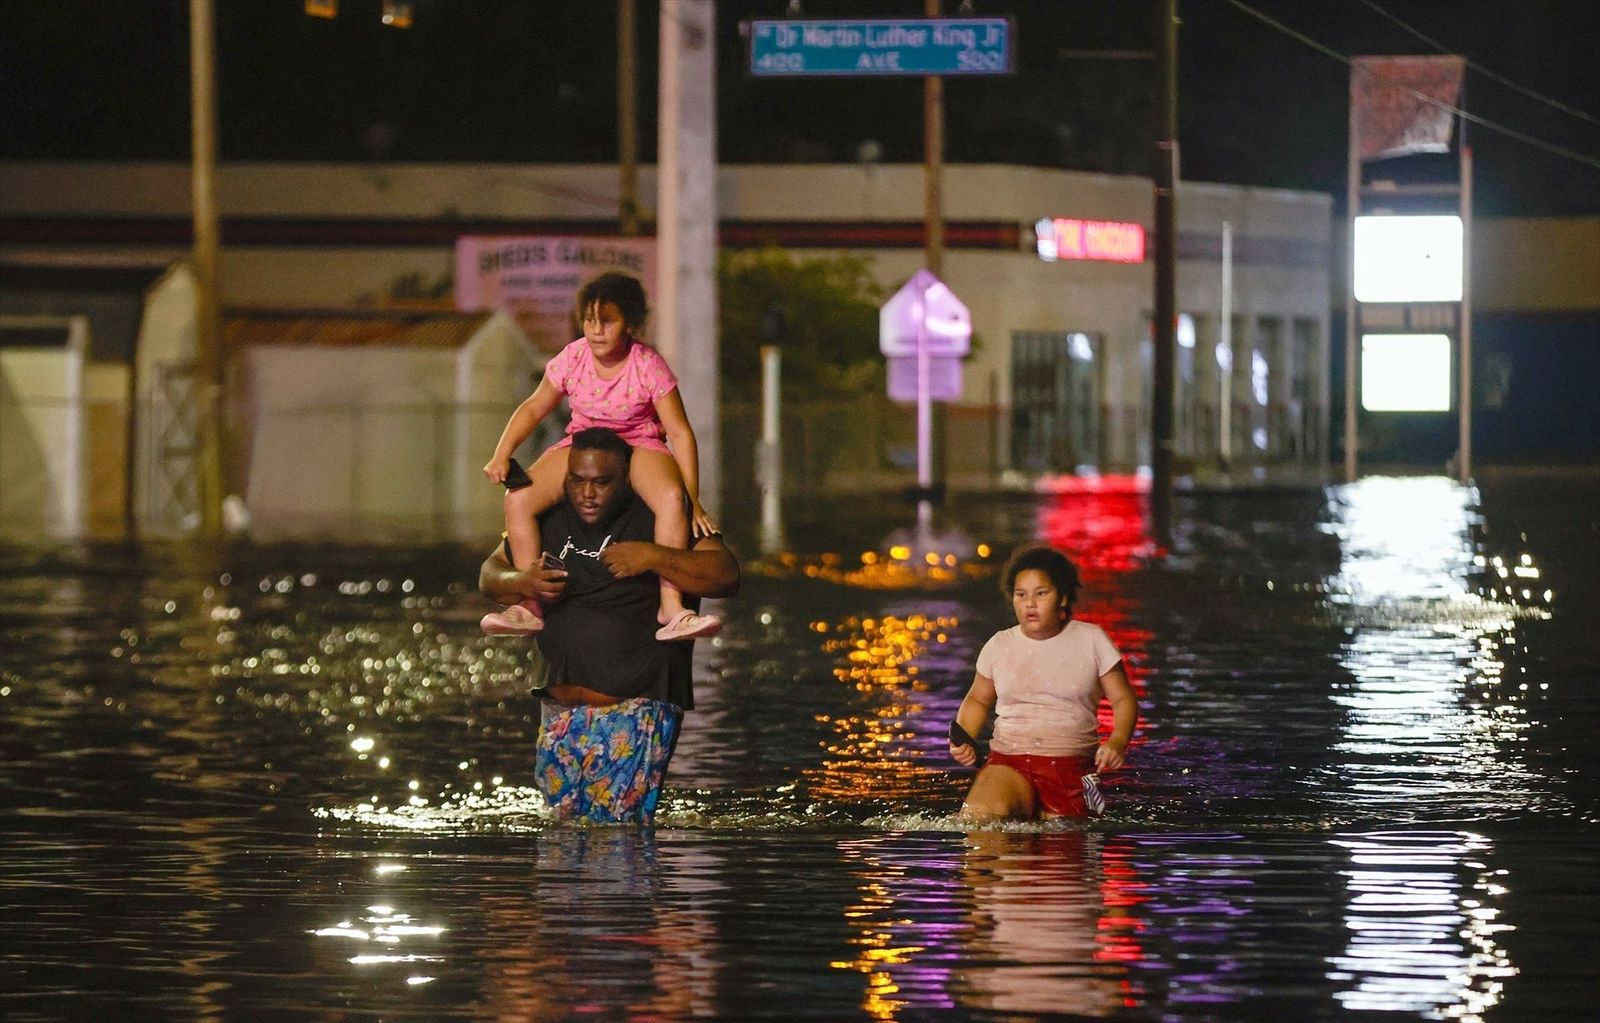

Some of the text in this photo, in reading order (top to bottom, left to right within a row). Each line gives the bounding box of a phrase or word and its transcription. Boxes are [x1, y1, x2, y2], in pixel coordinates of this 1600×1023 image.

[776, 25, 797, 48] Dr
[803, 25, 862, 48] Martin
[865, 25, 927, 48] Luther
[933, 24, 976, 50] King
[981, 24, 999, 47] Jr
[857, 51, 899, 70] AVE
